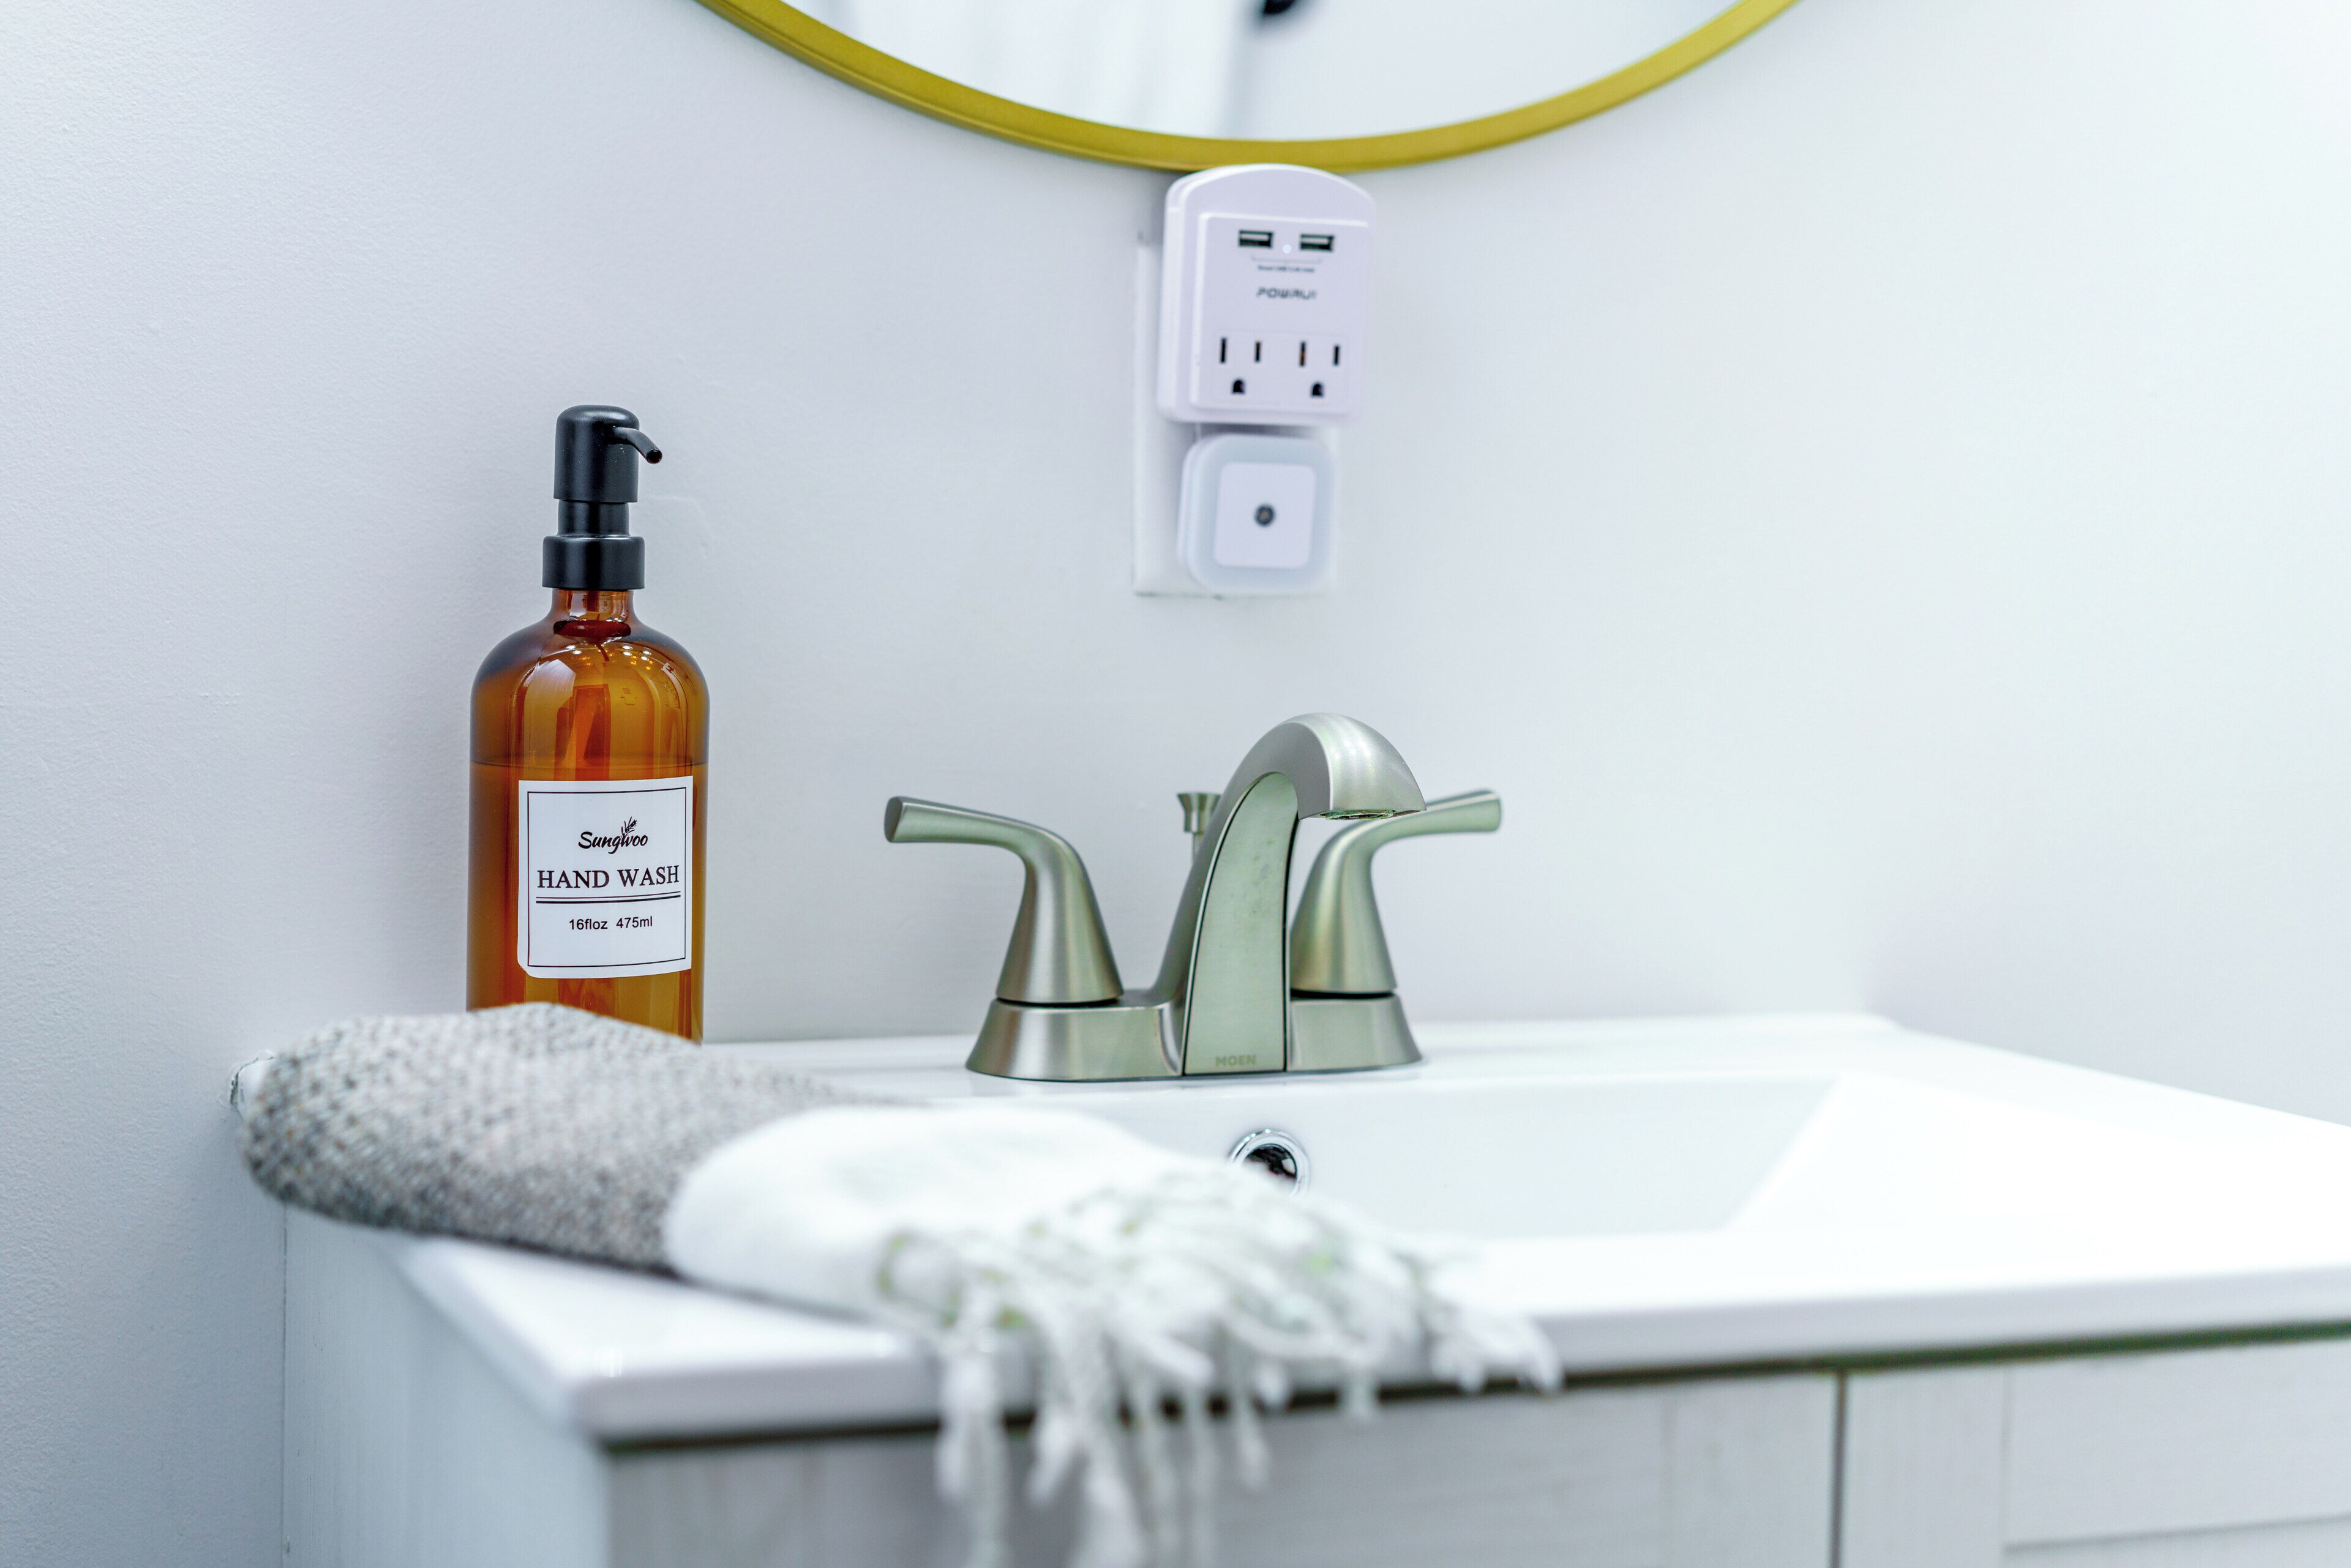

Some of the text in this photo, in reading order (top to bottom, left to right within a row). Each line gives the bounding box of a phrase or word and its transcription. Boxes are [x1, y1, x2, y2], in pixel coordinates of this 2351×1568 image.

[578, 831, 648, 854] Sungwoo
[537, 865, 680, 888] HAND WASH
[569, 916, 653, 930] 16floz 475ml
[1215, 1054, 1256, 1066] MOEN
